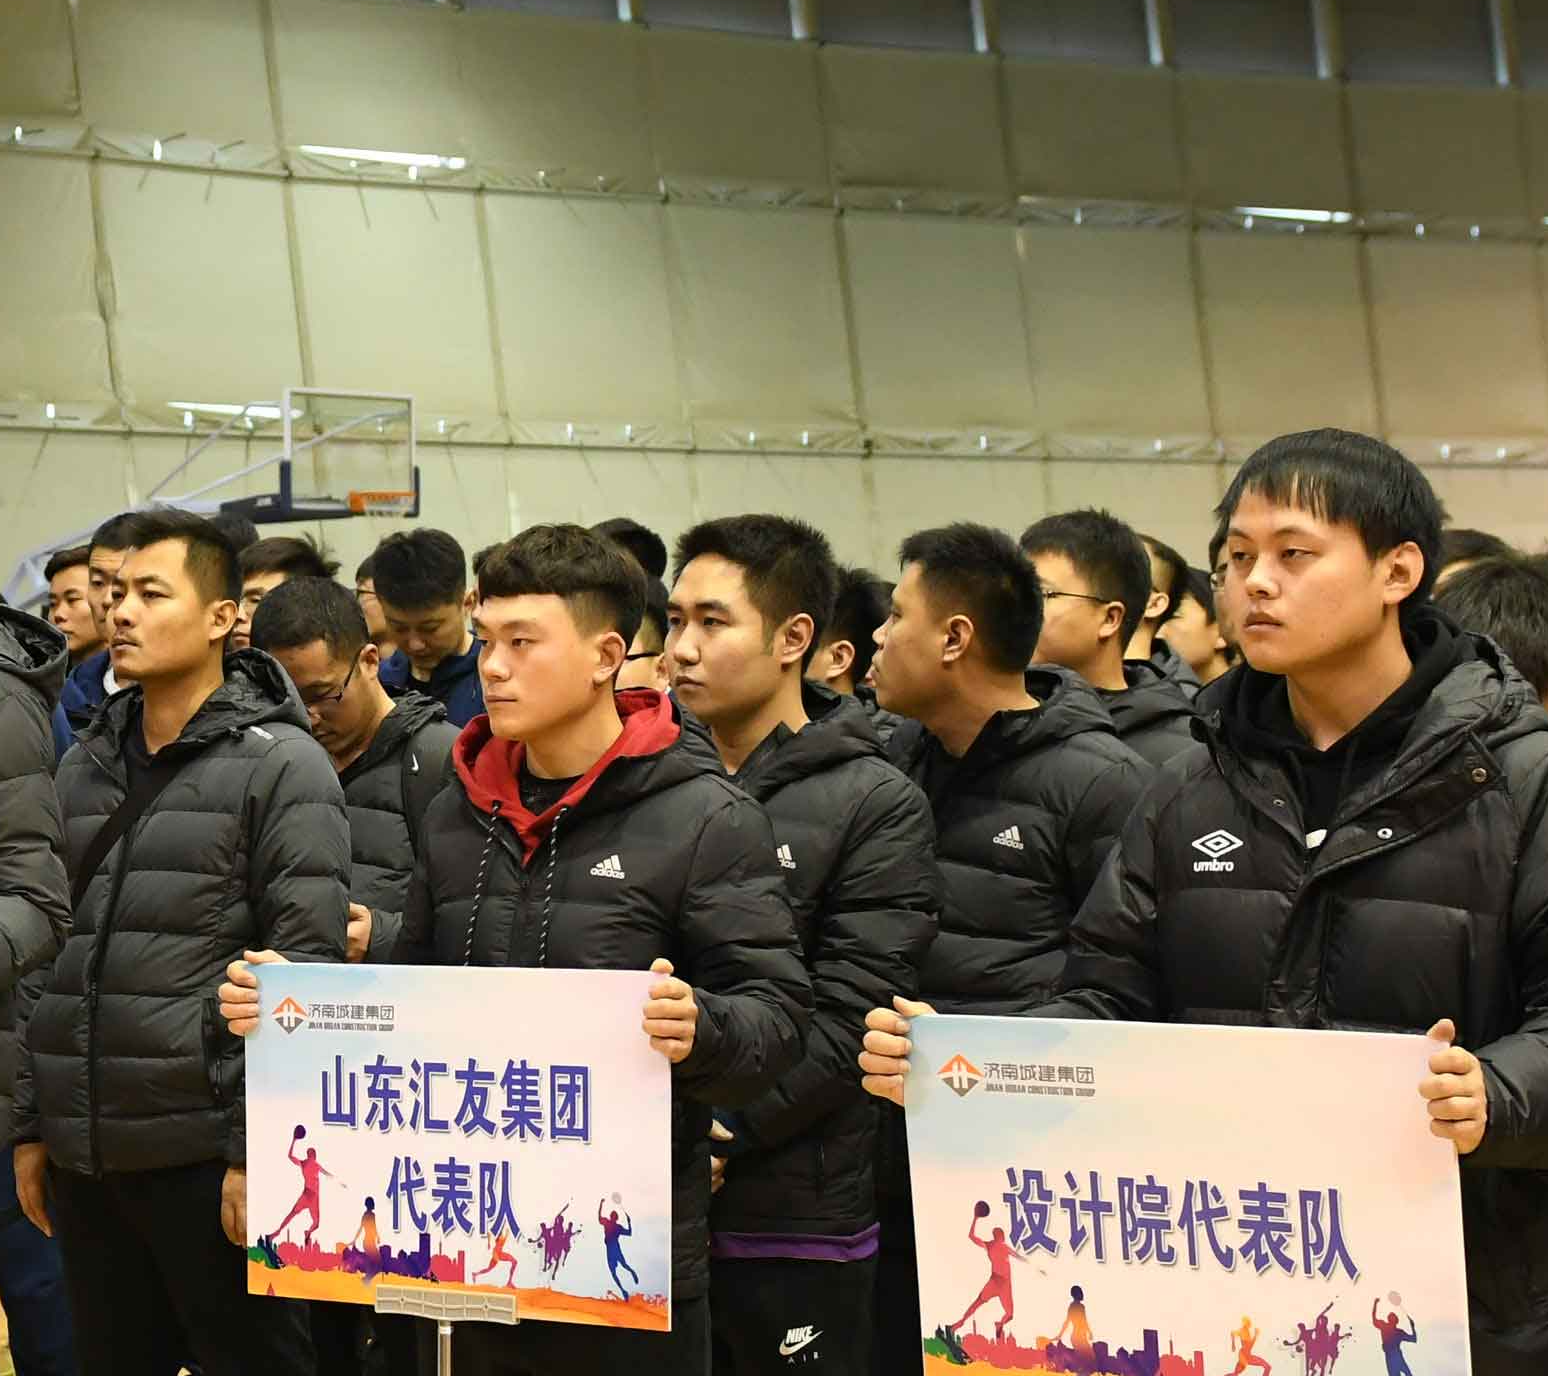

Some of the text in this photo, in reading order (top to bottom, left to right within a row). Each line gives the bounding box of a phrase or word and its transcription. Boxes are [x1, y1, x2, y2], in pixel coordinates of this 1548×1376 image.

[993, 836, 1024, 850] adidas
[590, 867, 625, 880] adidas
[1194, 859, 1234, 872] umbro
[308, 1003, 396, 1021] 济南城建集团
[983, 1061, 1096, 1085] 济南城建集团
[320, 1054, 592, 1143] 山东汇友集团
[385, 1155, 522, 1239] 代表队
[1004, 1166, 1360, 1281] 设计院代表队
[786, 1325, 815, 1344] NIKE
[787, 1351, 819, 1364] AIR
